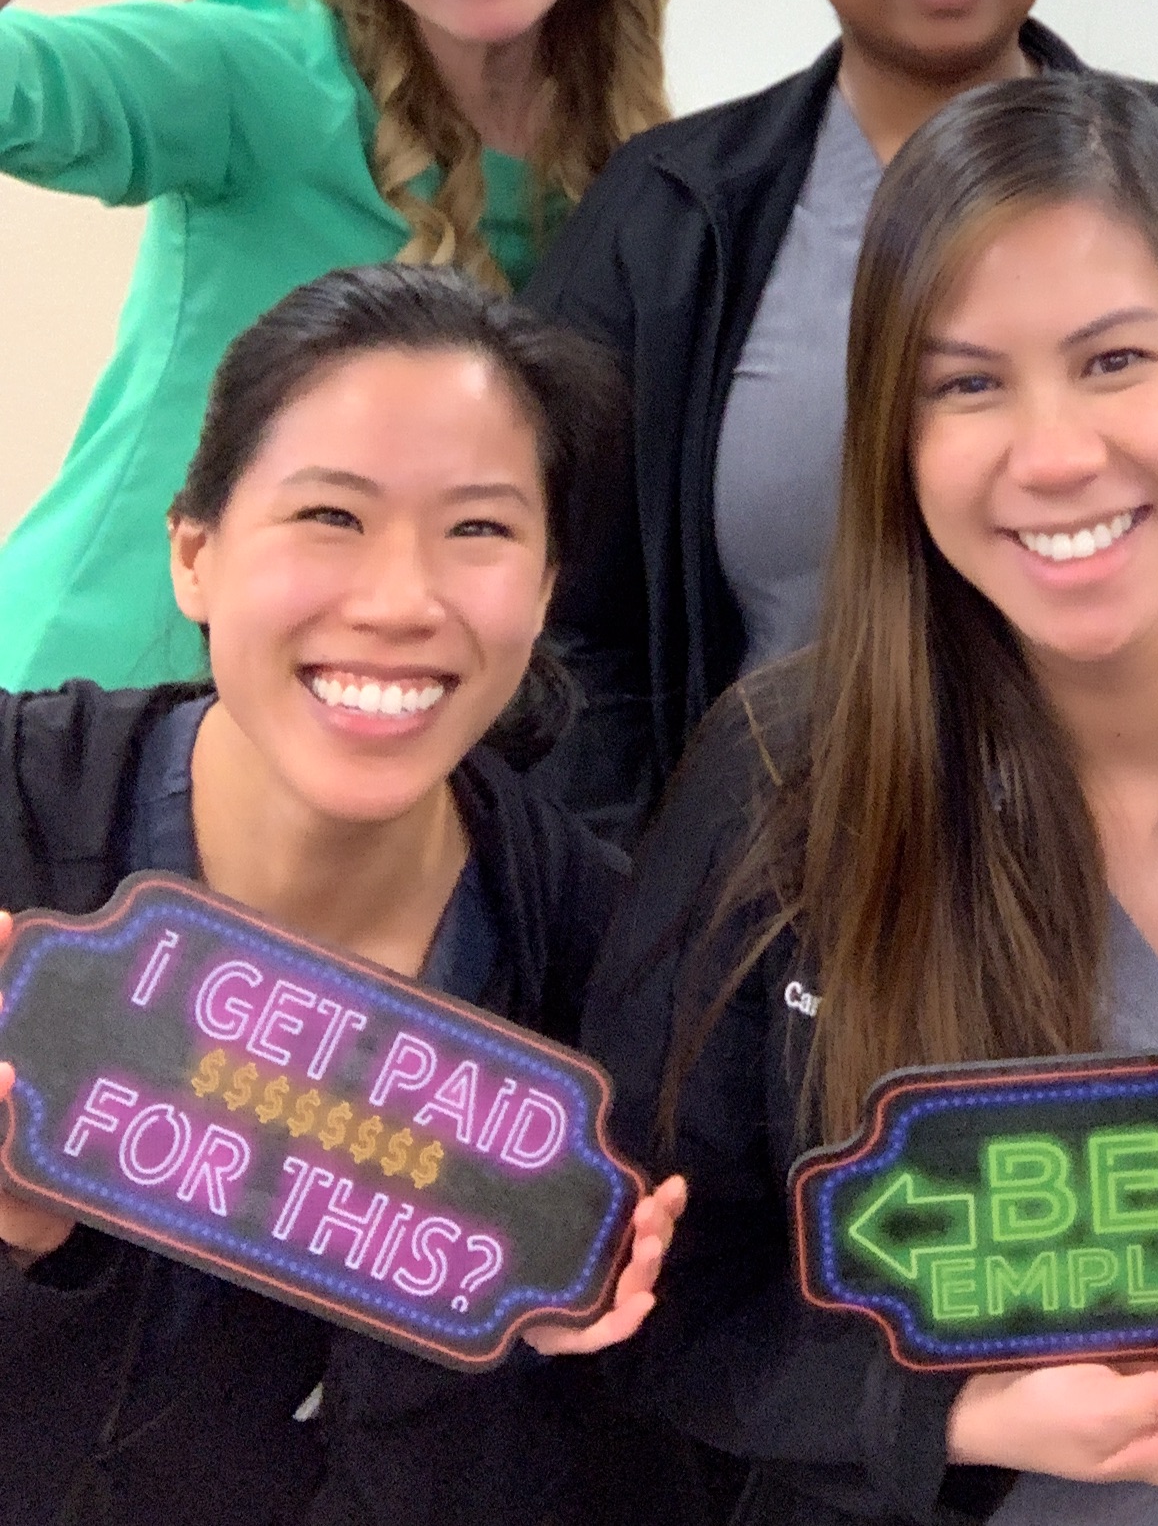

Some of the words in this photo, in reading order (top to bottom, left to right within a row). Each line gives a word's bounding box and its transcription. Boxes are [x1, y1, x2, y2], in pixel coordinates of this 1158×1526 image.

[131, 930, 179, 1007] I
[195, 960, 367, 1080] GET
[369, 1032, 568, 1169] PAID
[64, 1077, 251, 1217] FOR
[272, 1155, 504, 1313] THIS?
